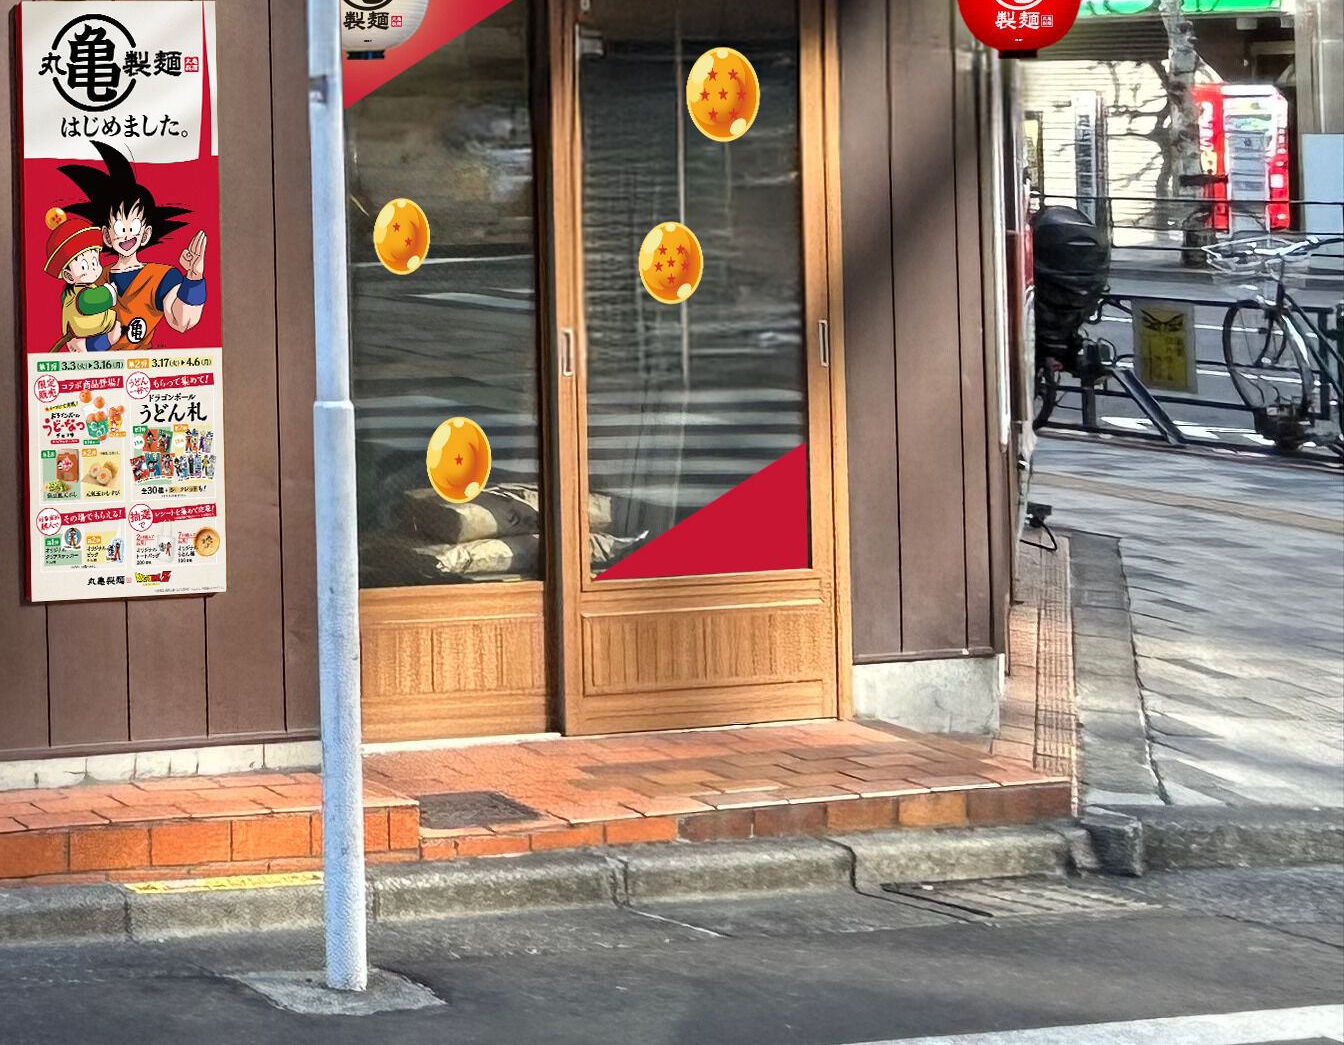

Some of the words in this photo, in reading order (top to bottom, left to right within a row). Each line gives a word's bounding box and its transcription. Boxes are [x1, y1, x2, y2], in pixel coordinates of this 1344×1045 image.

[38, 24, 183, 102] 丸亀製麺
[61, 114, 189, 138] はじめました。
[149, 392, 196, 402] ドラゴンボール
[140, 402, 207, 424] うどん札
